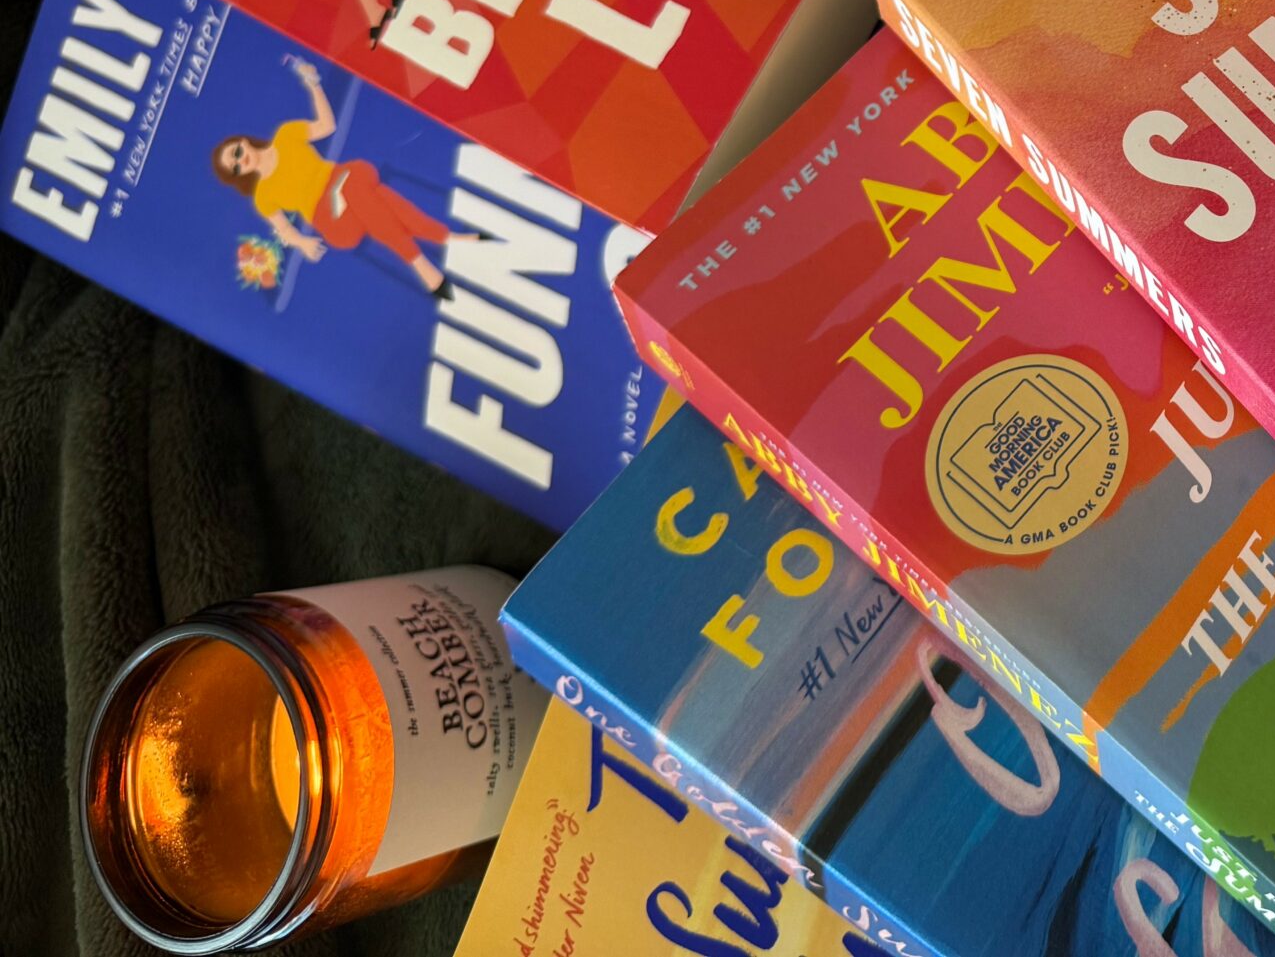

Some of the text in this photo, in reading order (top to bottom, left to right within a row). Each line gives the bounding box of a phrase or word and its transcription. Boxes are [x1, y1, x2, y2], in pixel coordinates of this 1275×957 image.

[180, 4, 221, 94] HAPPY
[109, 18, 188, 219] #1 NEW YORK TIMES
[678, 240, 737, 293] THE
[743, 202, 776, 237] #1
[780, 138, 840, 202] NEW
[846, 69, 916, 137] YORK
[1021, 133, 1227, 375] SUMMERS
[621, 364, 644, 444] NOVEL
[989, 416, 1026, 455] GOOD
[989, 415, 1042, 473] MORNING
[994, 417, 1063, 491] AMERICA
[1003, 416, 1120, 545] A GMA BOOK CLUB PICK!
[1011, 431, 1071, 496] BOOK CLUB
[724, 412, 842, 530] ABBY
[862, 535, 1100, 763] JIMENEZ
[397, 615, 463, 734] BEACH
[410, 597, 488, 751] COMBER
[798, 648, 837, 701] #1
[834, 596, 886, 657] New
[396, 668, 415, 712] summer
[408, 718, 419, 737] the
[555, 674, 637, 748] One
[1133, 789, 1181, 836] THE
[1169, 811, 1258, 883] JUST
[559, 851, 596, 928] Niven
